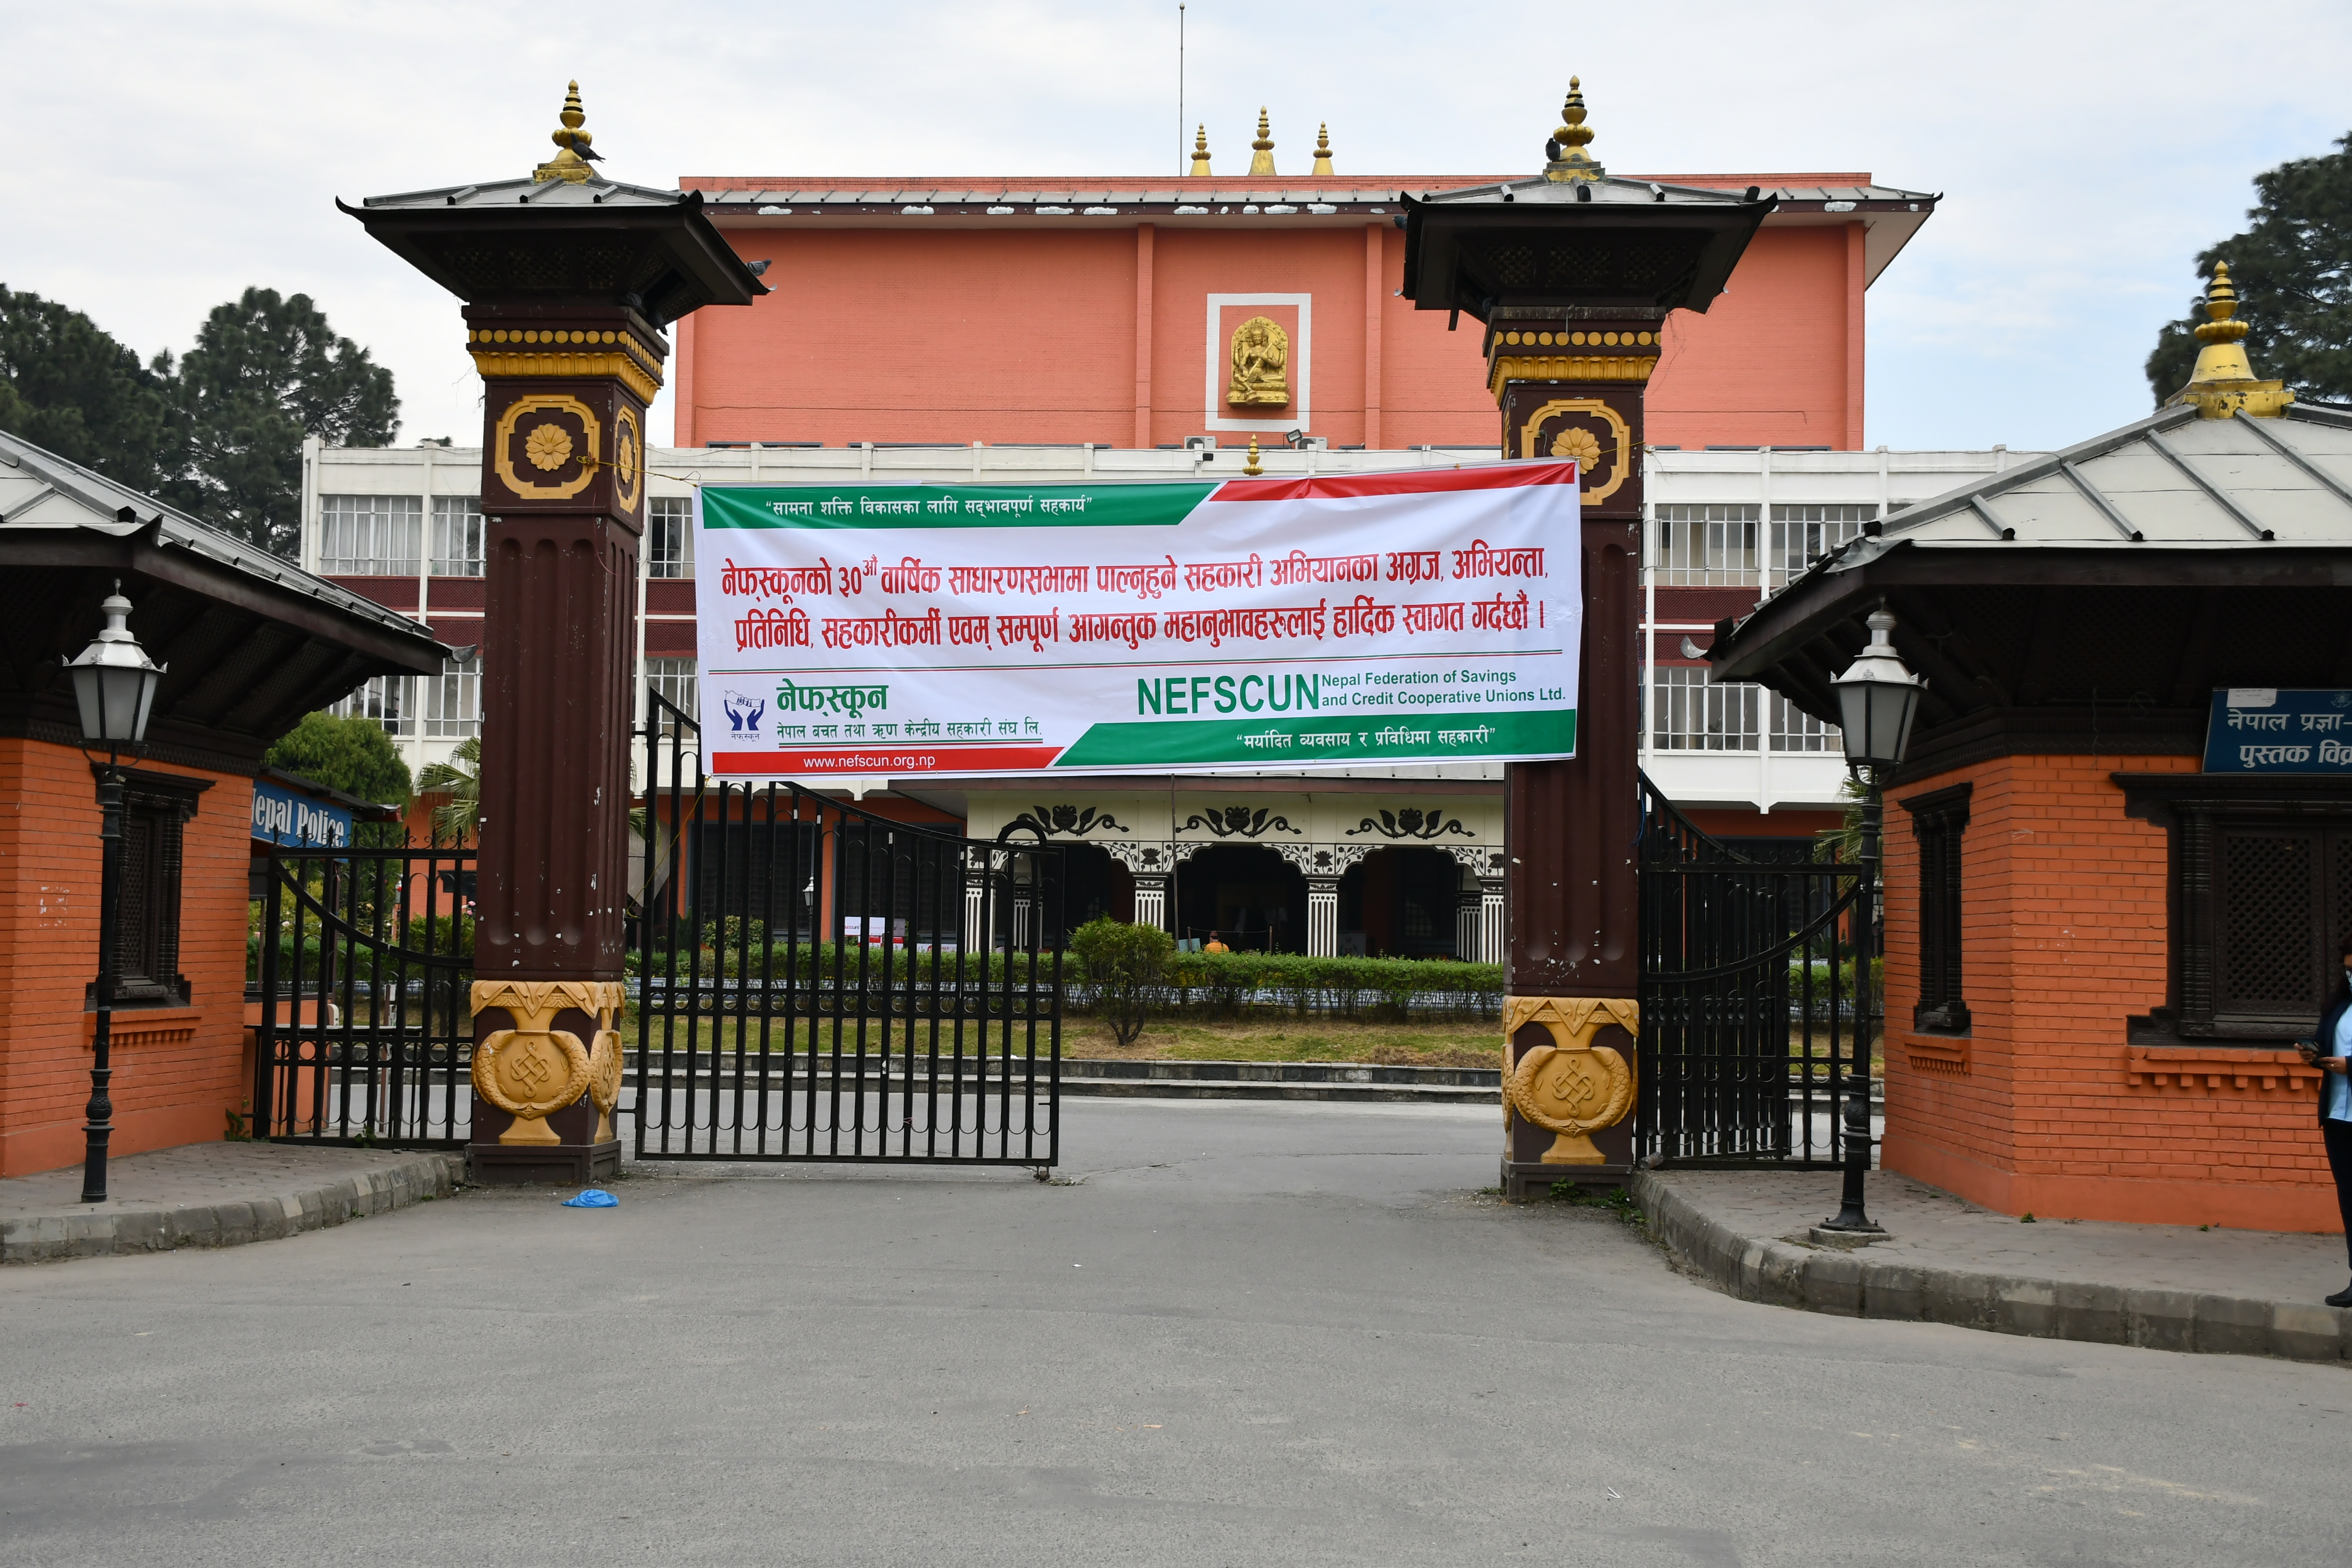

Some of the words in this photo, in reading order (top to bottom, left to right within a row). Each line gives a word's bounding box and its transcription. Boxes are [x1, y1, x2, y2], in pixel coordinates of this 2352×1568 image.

[820, 496, 853, 515] शक्ति
[860, 496, 920, 514] विकासका
[927, 495, 958, 514] लागि
[881, 556, 942, 594] वार्षिक
[948, 565, 1089, 595] साधारणसभामा
[1096, 555, 1178, 599] पाल्नुहुने
[1184, 553, 1263, 592] सहकारी
[1269, 550, 1379, 586] अभियानका
[1386, 551, 1445, 585] अग्रज,
[1451, 539, 1548, 580] अभियन्ता,
[734, 608, 814, 653] प्रतिनिधि,
[821, 608, 942, 649] सहकारीकर्मी
[948, 616, 992, 651] एवम्
[996, 607, 1059, 653] सम्पूर्ण
[1068, 613, 1157, 650] आगन्तुक
[1333, 595, 1396, 638] हार्दिक
[1402, 602, 1465, 635] स्वागत
[1321, 674, 1361, 688] Nepal
[1365, 672, 1438, 685] Federation
[1443, 670, 1457, 683] of
[1460, 669, 1516, 684] Savings
[1137, 674, 1319, 715] NEFSCUN
[1321, 693, 1347, 707] and
[1352, 692, 1393, 706] Credit
[1398, 691, 1481, 706] Cooperative
[1486, 689, 1535, 702] Unions
[1540, 687, 1566, 700] Ltd.
[777, 722, 806, 738] नेपाल
[812, 725, 838, 738] बचत
[844, 724, 866, 738] तथा
[872, 723, 898, 739] ऋण
[904, 718, 940, 737] केन्द्रीय
[947, 717, 992, 739] सहकारी
[998, 719, 1018, 736] संघ
[1024, 716, 1042, 735] लि.
[2227, 709, 2291, 731] नेपाल
[1299, 732, 1350, 748] व्यवसाय
[1358, 733, 1367, 746] र
[1375, 726, 1430, 746] प्रविधिमा
[803, 755, 936, 769] www.nefscun.org.np
[2239, 745, 2312, 768] पुस्तक
